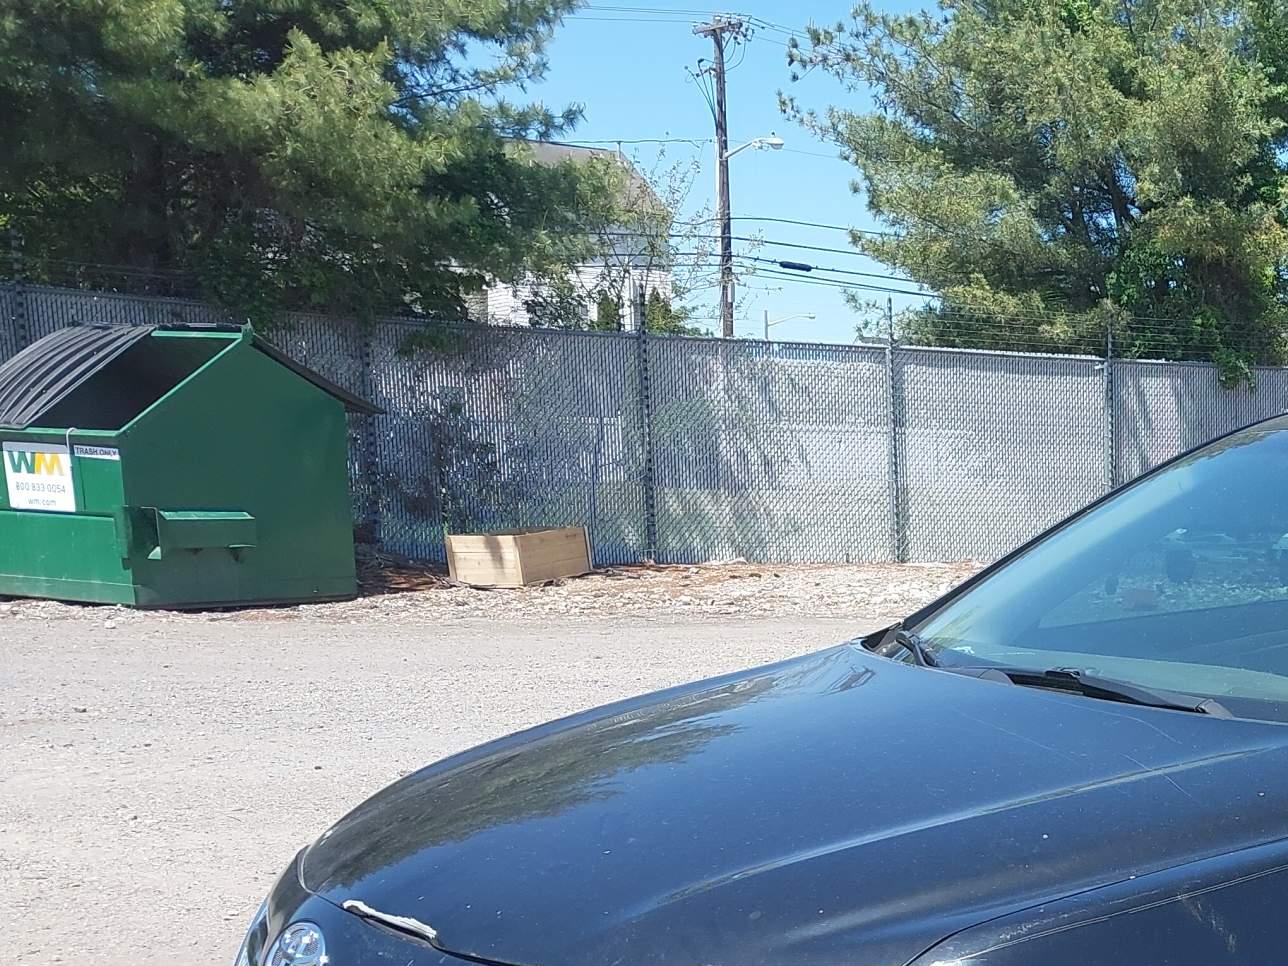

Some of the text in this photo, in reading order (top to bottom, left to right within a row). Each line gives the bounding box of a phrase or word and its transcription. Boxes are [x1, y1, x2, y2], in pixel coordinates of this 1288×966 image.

[75, 447, 97, 455] TRASH
[8, 450, 64, 476] WM
[16, 481, 29, 491] 800
[28, 498, 56, 506] wm.com
